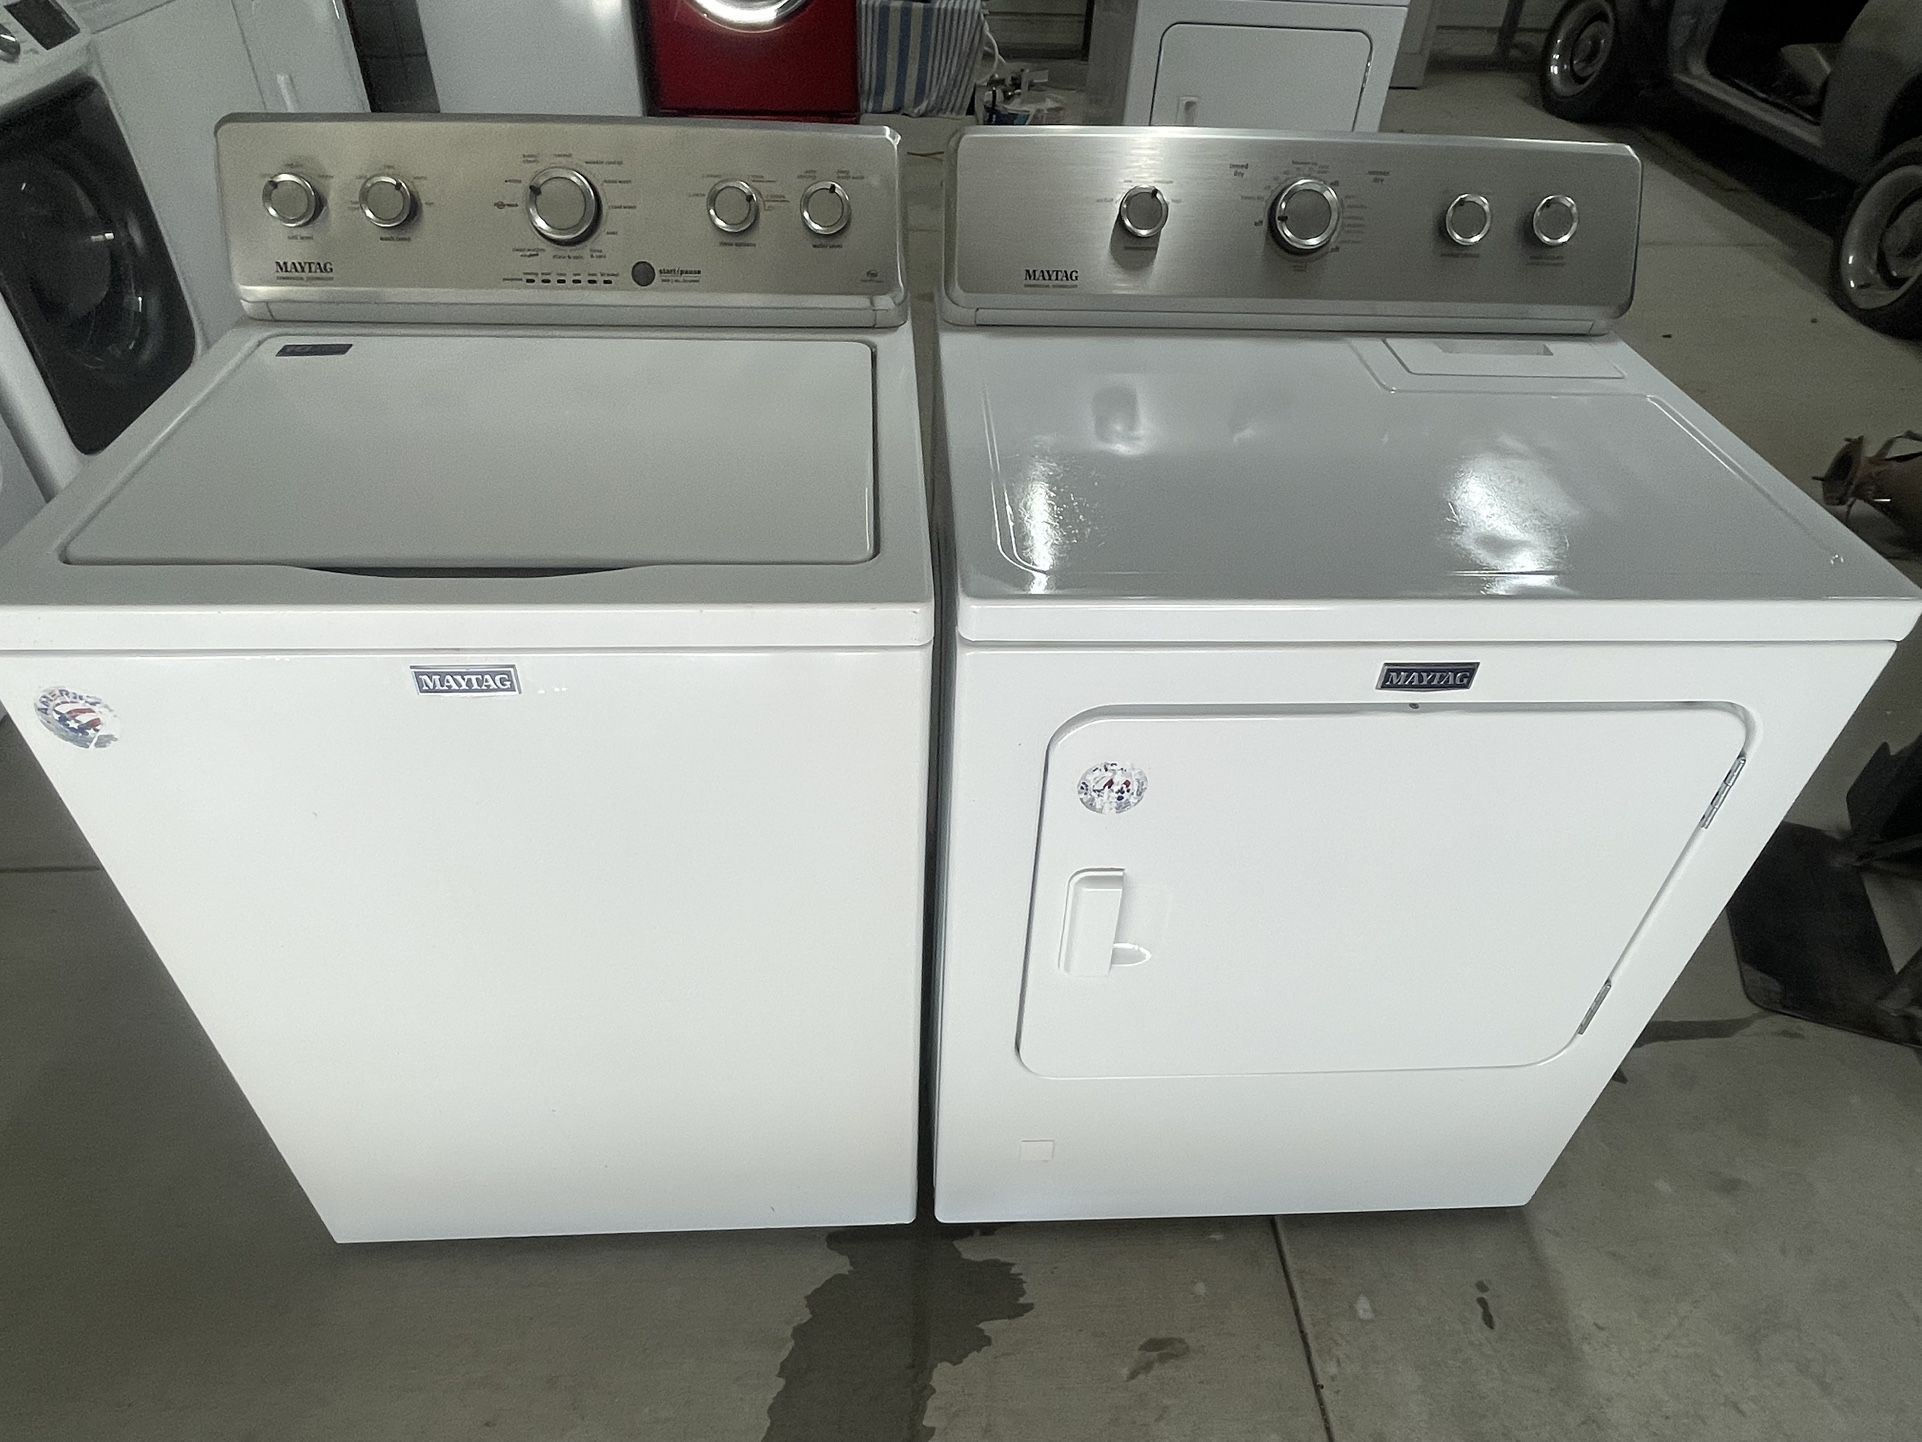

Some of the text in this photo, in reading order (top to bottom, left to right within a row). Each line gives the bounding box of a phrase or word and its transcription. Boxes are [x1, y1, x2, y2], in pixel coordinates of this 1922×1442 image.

[275, 261, 334, 274] MAYTAG
[658, 267, 702, 277] start/pause
[1024, 269, 1079, 282] MAYTAG
[418, 674, 512, 691] MAYTAG
[1385, 671, 1471, 686] MAYTAG
